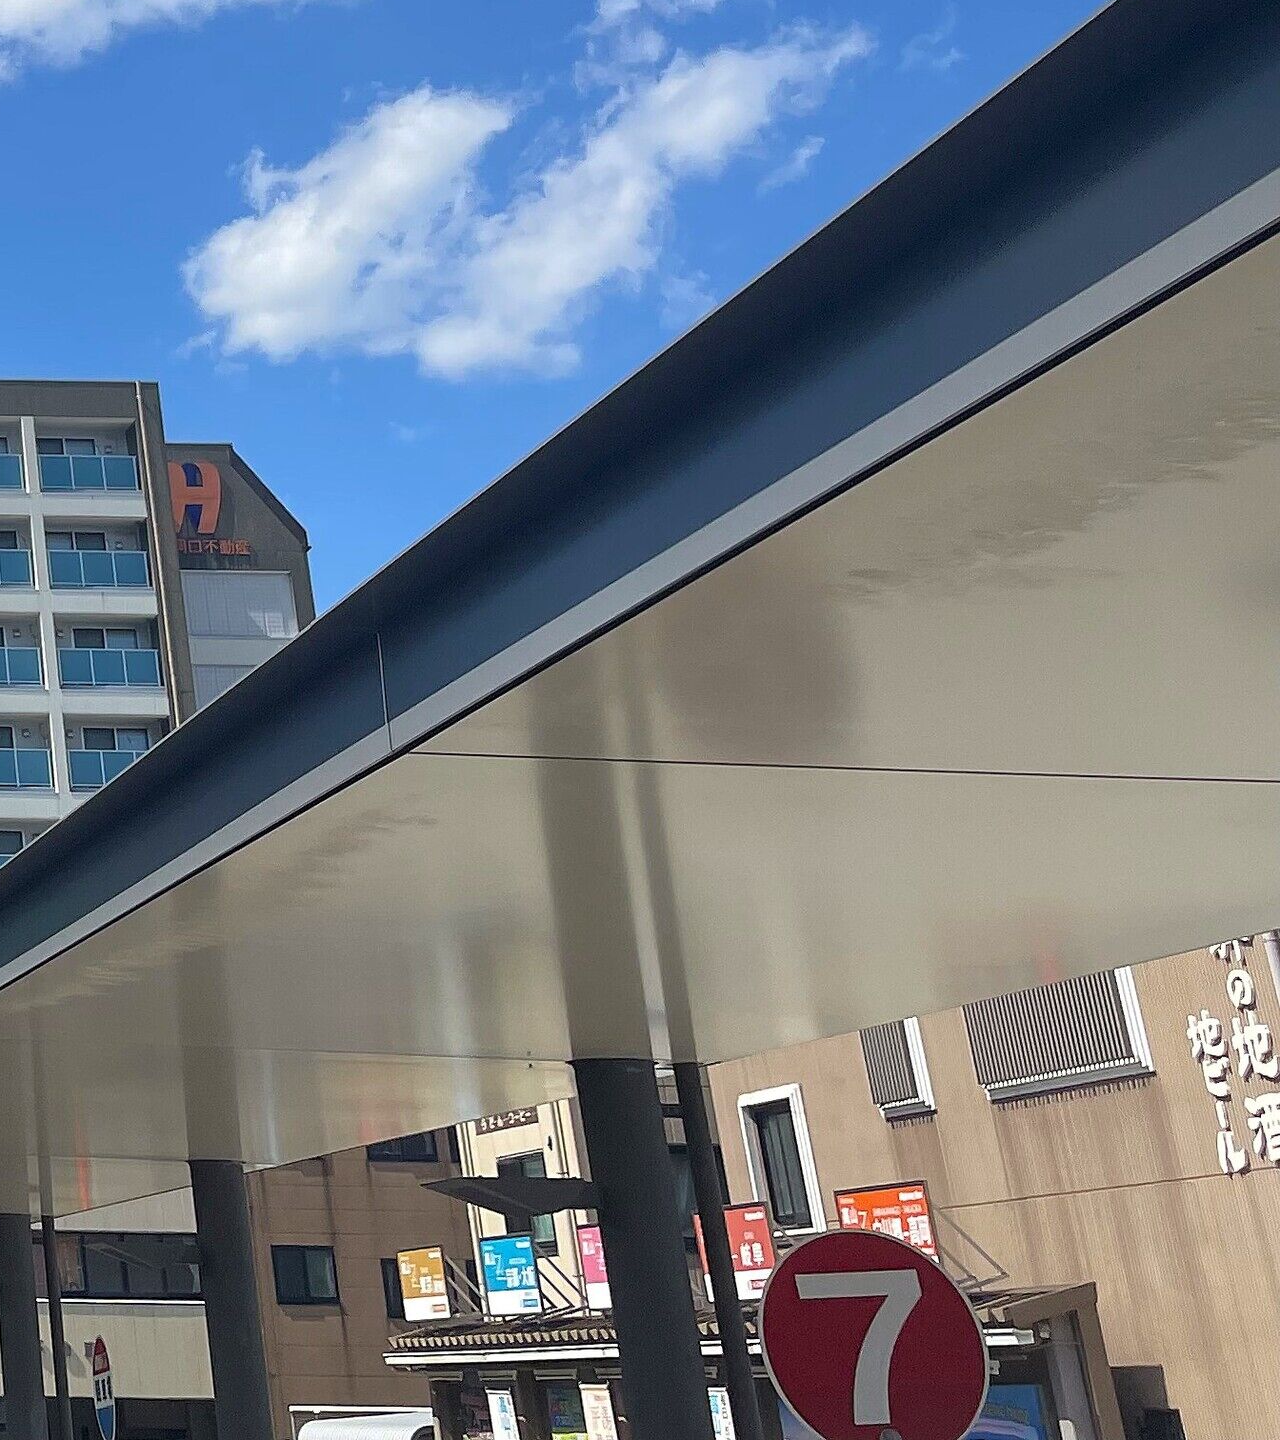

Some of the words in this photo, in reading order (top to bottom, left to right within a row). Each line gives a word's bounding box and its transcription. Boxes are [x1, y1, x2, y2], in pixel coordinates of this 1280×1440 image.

[1187, 1009, 1246, 1174] 地ビール
[795, 1268, 922, 1426] 7
